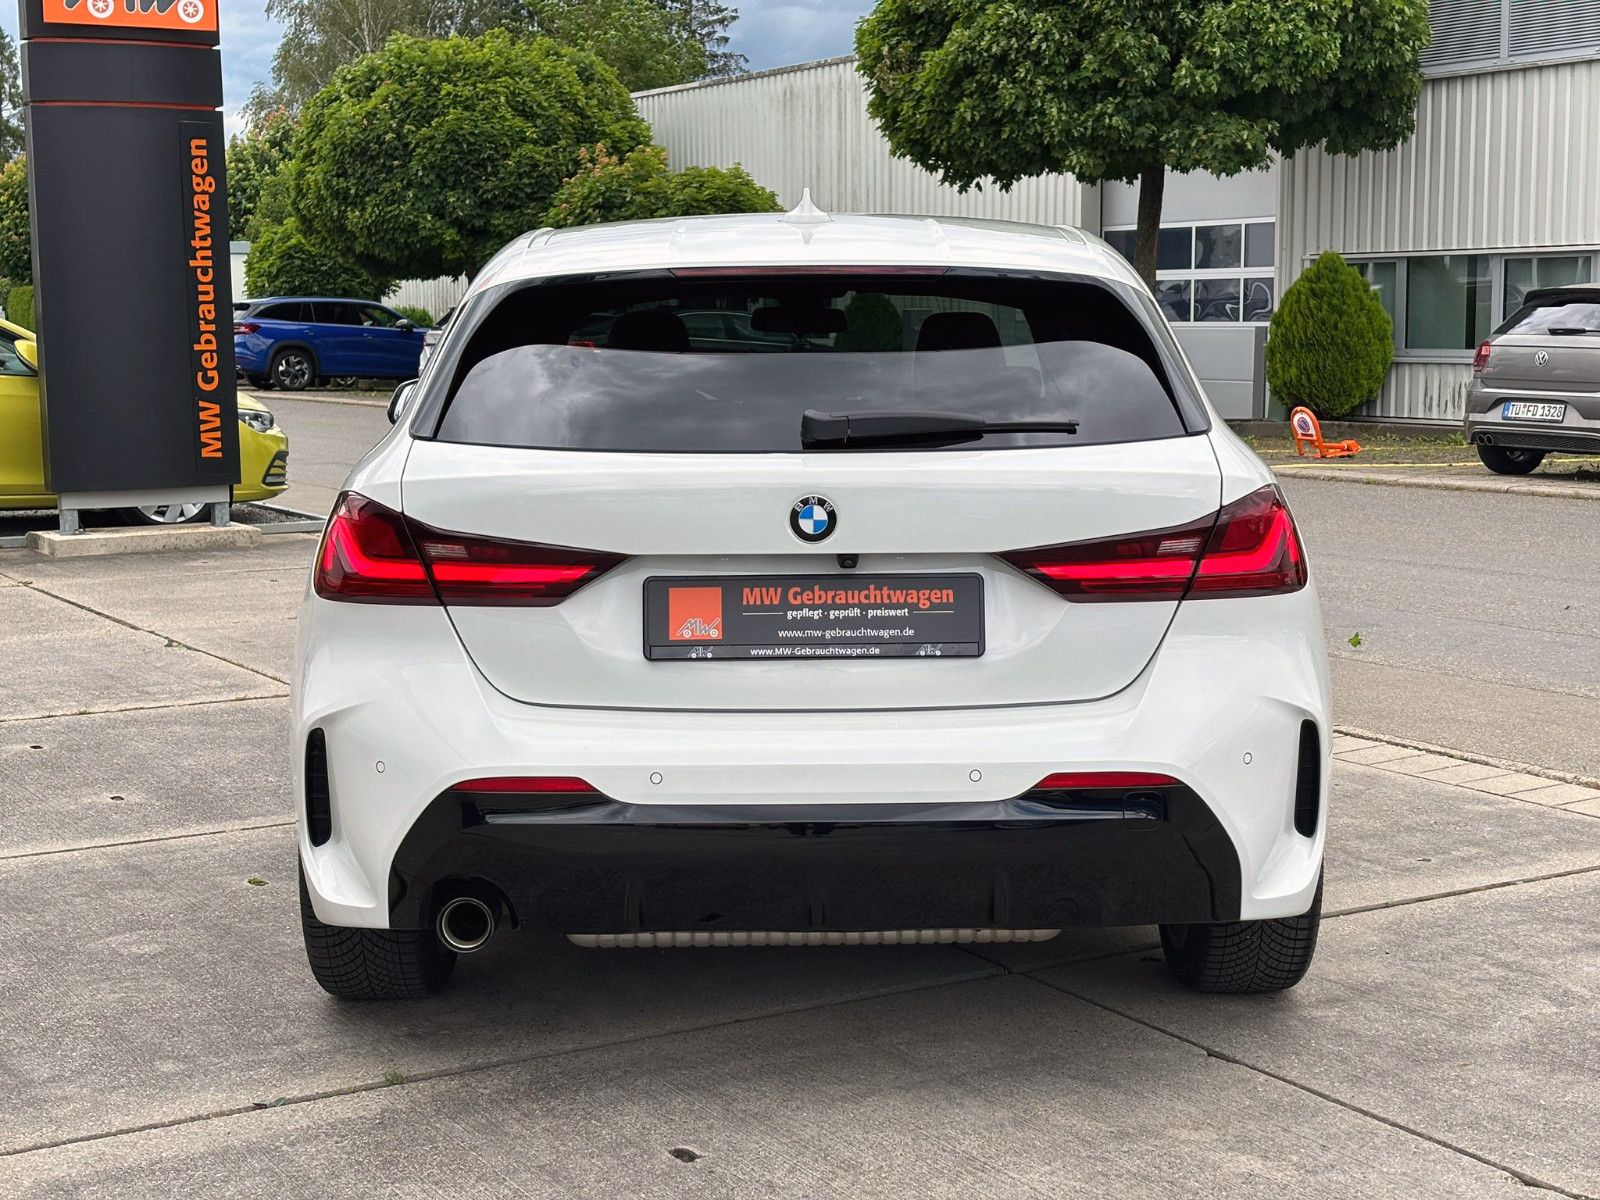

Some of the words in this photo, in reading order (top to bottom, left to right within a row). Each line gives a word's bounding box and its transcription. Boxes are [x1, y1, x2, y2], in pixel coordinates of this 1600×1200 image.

[189, 138, 220, 392] Gebrauchtwagen
[1526, 403, 1539, 417] FD
[1540, 405, 1563, 418] 1328
[198, 400, 223, 458] MW
[794, 496, 833, 512] BMW
[742, 586, 782, 606] MW
[787, 584, 954, 609] Gebrauchtwagen
[786, 608, 823, 620] gepflegt
[829, 607, 861, 619] geprüft
[867, 607, 909, 619] preiswert
[777, 626, 915, 640] www.mw-gebrauchtwagen.de
[750, 646, 881, 656] www.MW-Gebrauchtwagen.de
